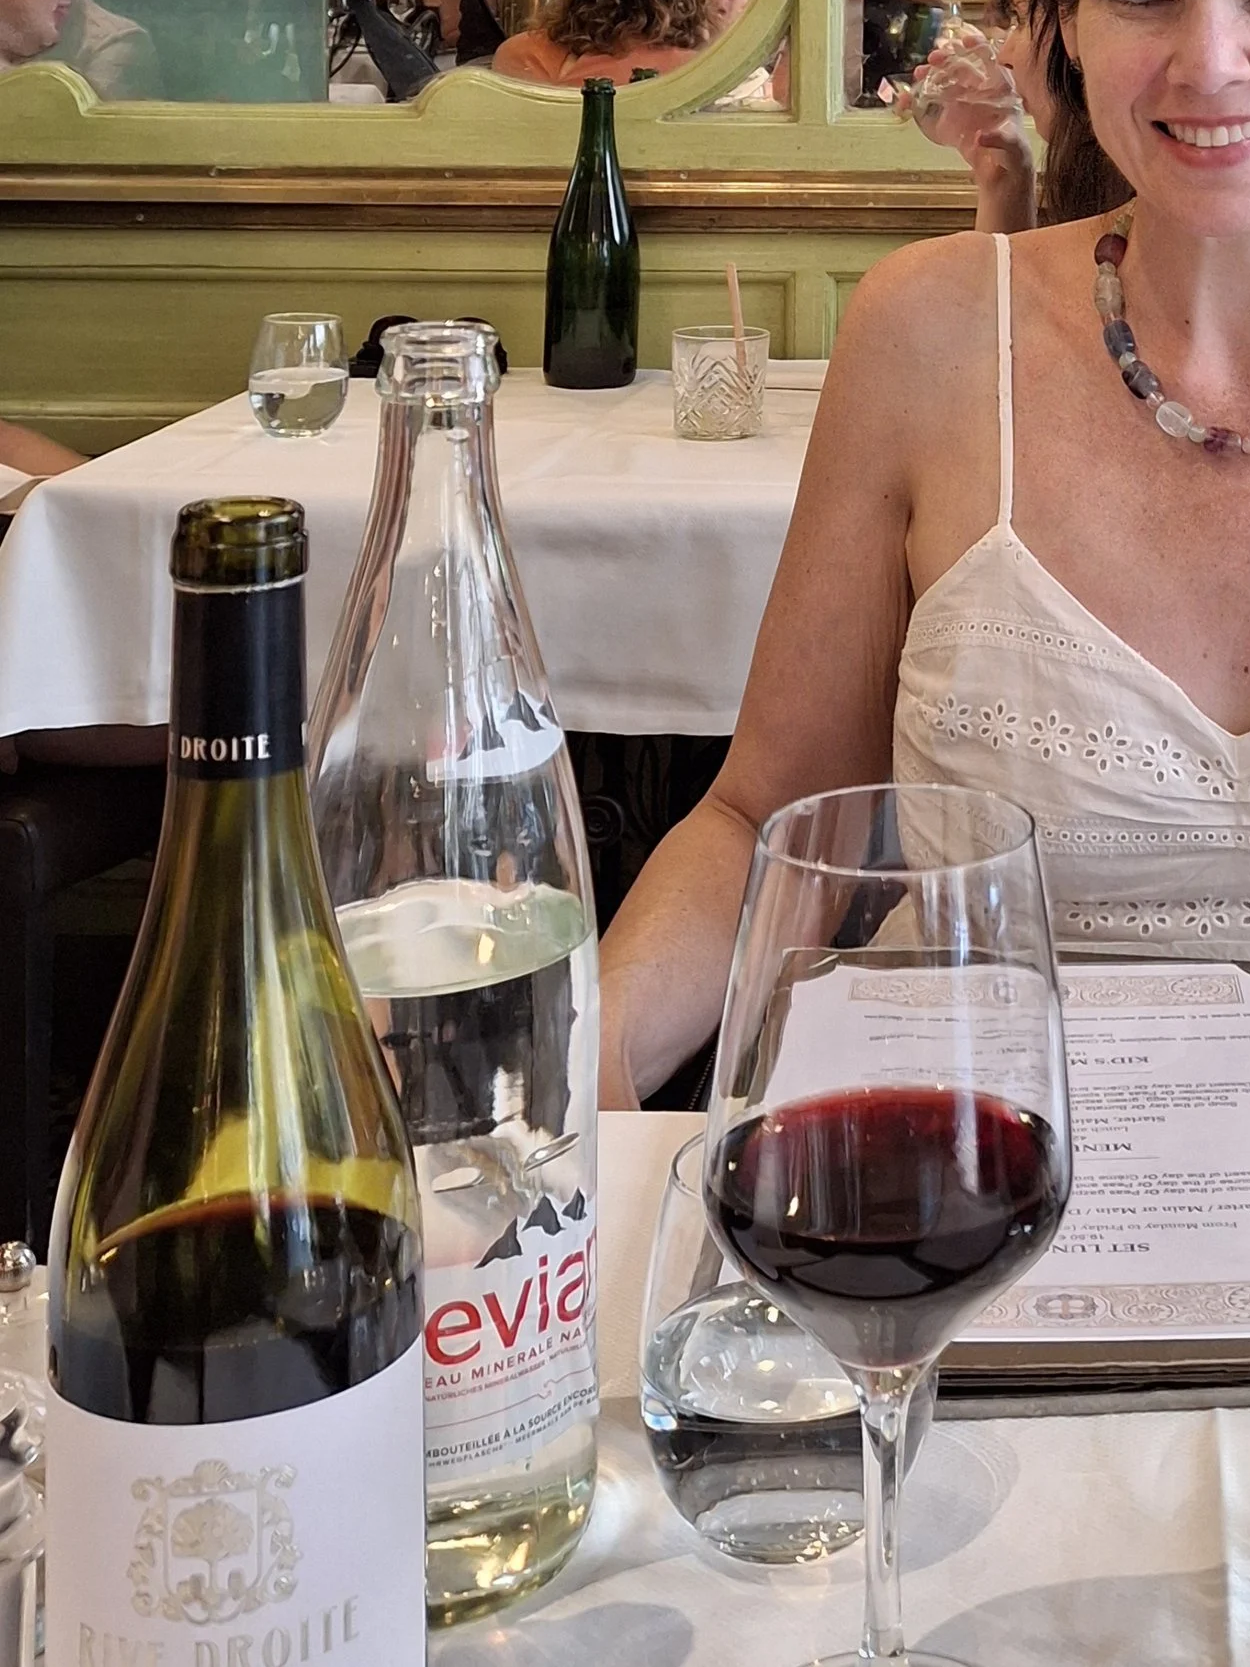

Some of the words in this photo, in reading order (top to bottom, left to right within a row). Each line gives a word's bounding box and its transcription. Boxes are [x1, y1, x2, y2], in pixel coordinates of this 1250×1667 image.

[179, 732, 272, 762] DROITE
[1094, 1056, 1148, 1065] KID'S
[1162, 1206, 1203, 1214] Main
[1144, 1222, 1198, 1230] Monday
[1058, 1244, 1100, 1253] LUN
[1108, 1243, 1149, 1253] SET
[425, 1372, 461, 1389] EAU
[471, 1336, 553, 1380] MINERALE
[513, 1422, 526, 1436] LA
[528, 1402, 562, 1429] SOURCE
[195, 1594, 361, 1667] DROITE
